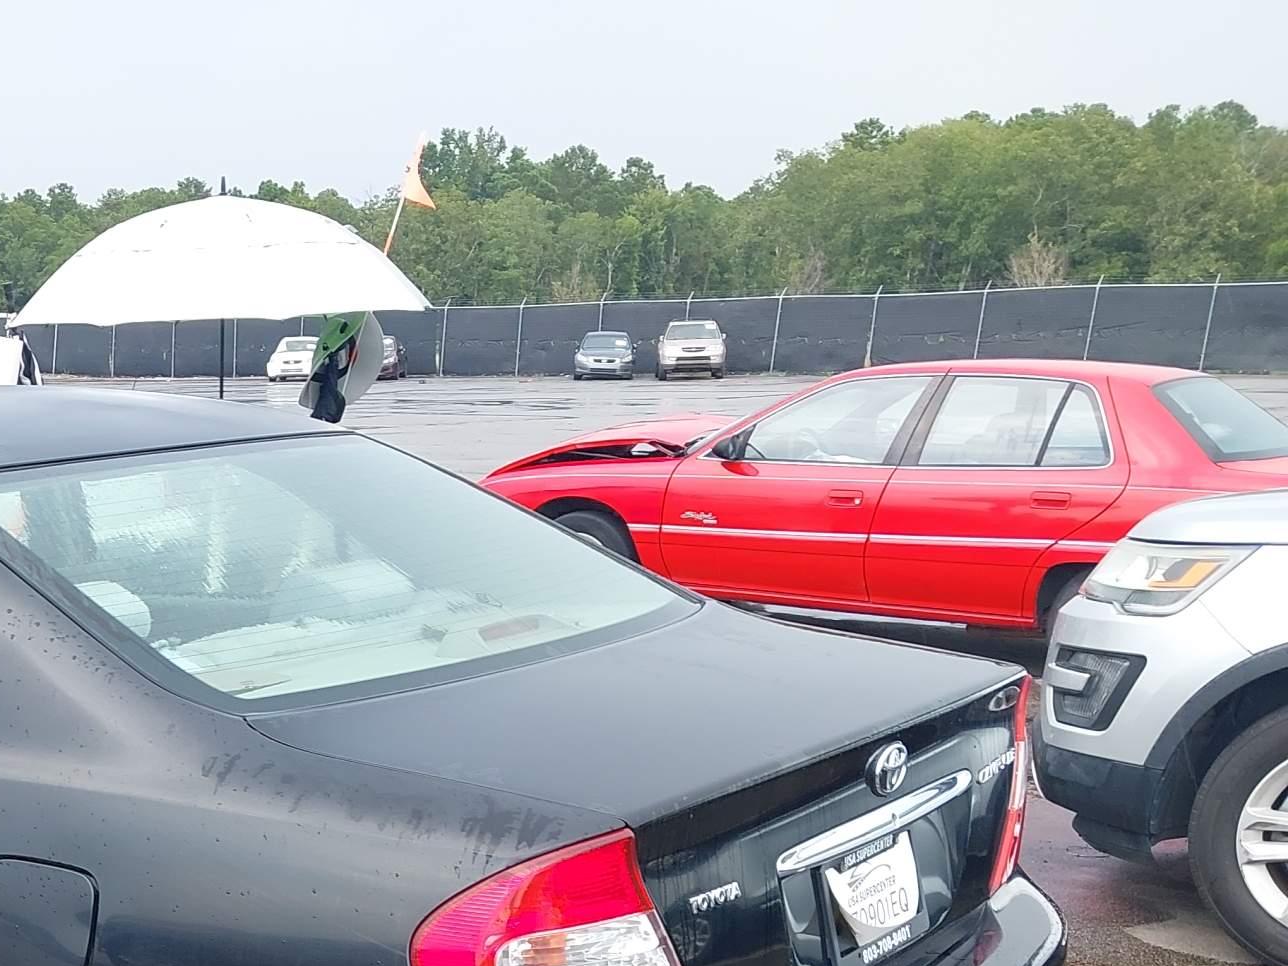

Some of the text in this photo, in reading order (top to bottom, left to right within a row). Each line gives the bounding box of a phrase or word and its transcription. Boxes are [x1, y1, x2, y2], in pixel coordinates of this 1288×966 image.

[857, 834, 894, 862] SUPERCENTER
[689, 881, 742, 914] TOYOTA
[860, 874, 896, 902] SUPERCENTER
[862, 924, 912, 964] 803-708-8401
